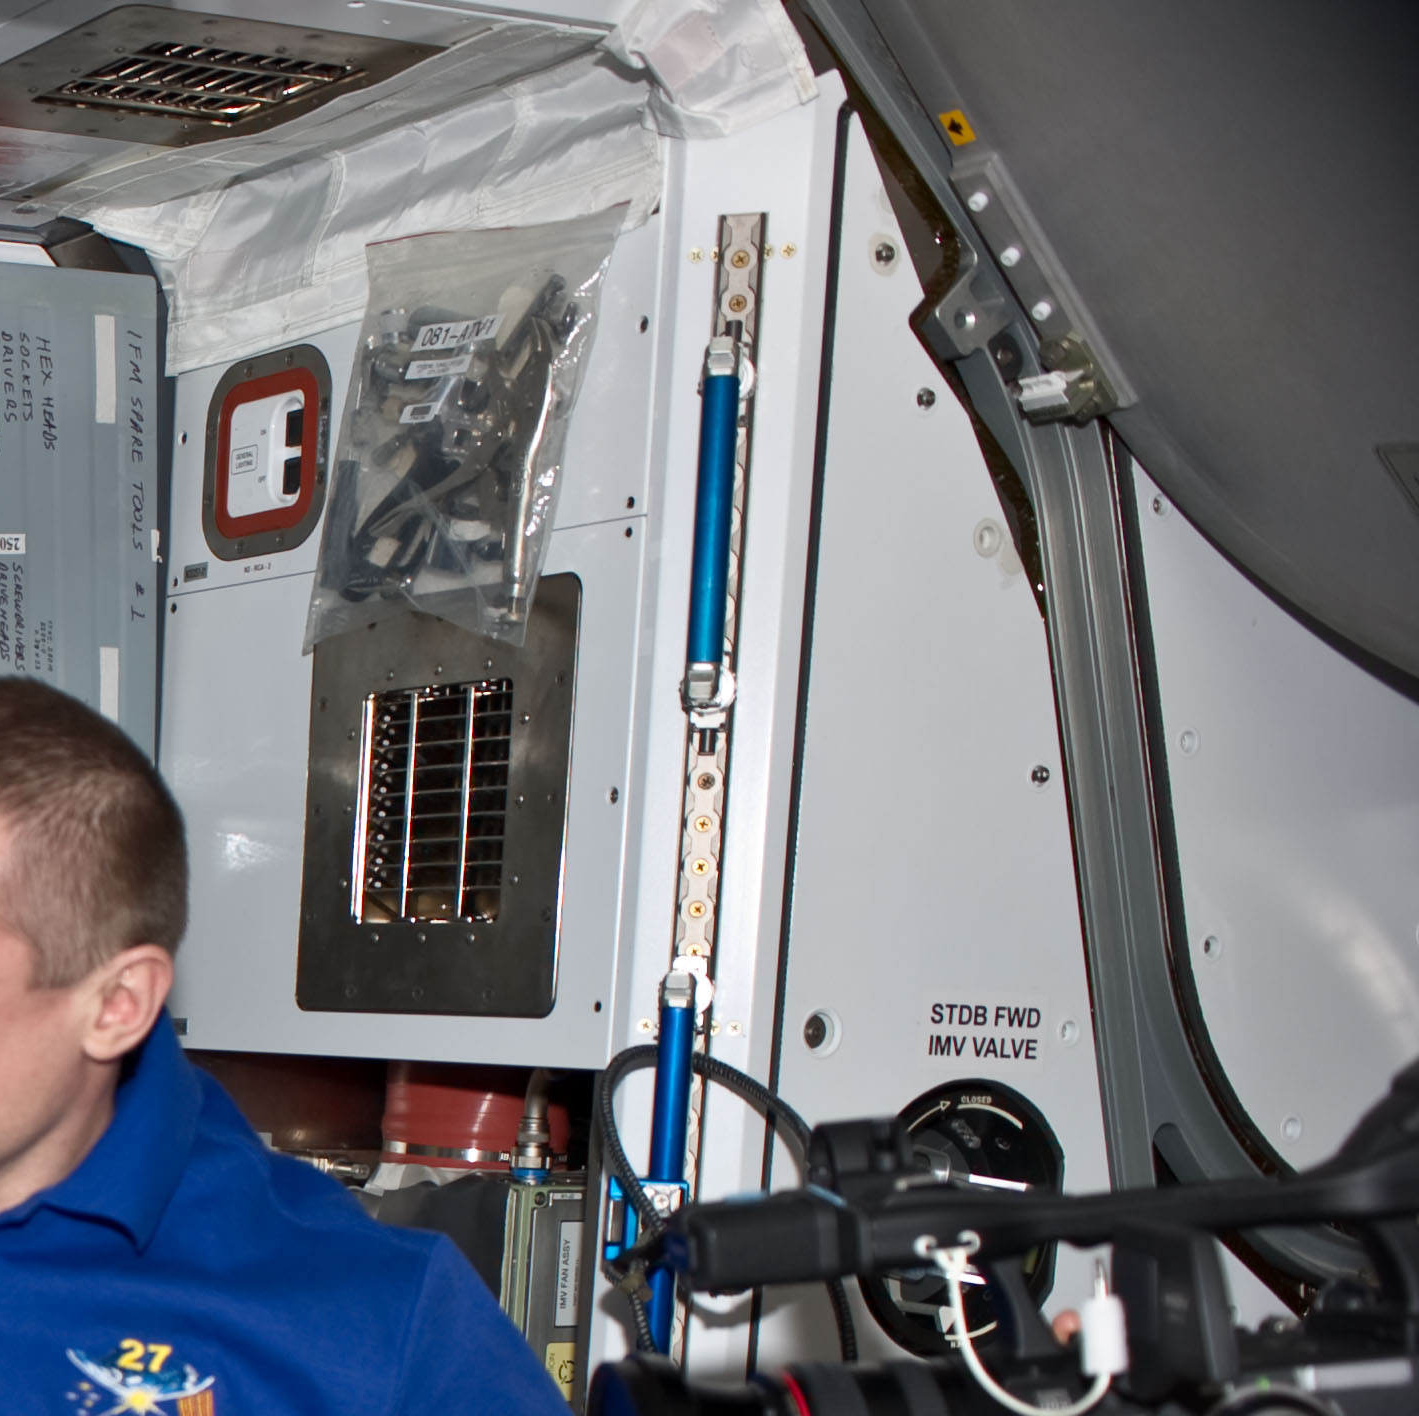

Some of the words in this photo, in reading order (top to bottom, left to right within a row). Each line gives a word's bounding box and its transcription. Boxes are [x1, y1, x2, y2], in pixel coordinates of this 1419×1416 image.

[1, 331, 17, 423] DRIVERS
[19, 331, 33, 421] SOCKETS
[36, 336, 52, 385] HEX
[42, 397, 58, 451] HEADS
[129, 397, 143, 463] SPARE
[236, 452, 253, 461] GENERAL
[236, 460, 253, 469] LIGHTING
[132, 481, 144, 550] TOOLS
[12, 562, 25, 672] SCREWDRIVERS
[930, 1003, 988, 1026] STDB
[995, 1006, 1041, 1028] FWD
[929, 1034, 966, 1056] IMV
[973, 1037, 1038, 1060] VALVE
[961, 1096, 992, 1104] CLOSED
[561, 1268, 569, 1287] FAN
[116, 1338, 173, 1373] 27
